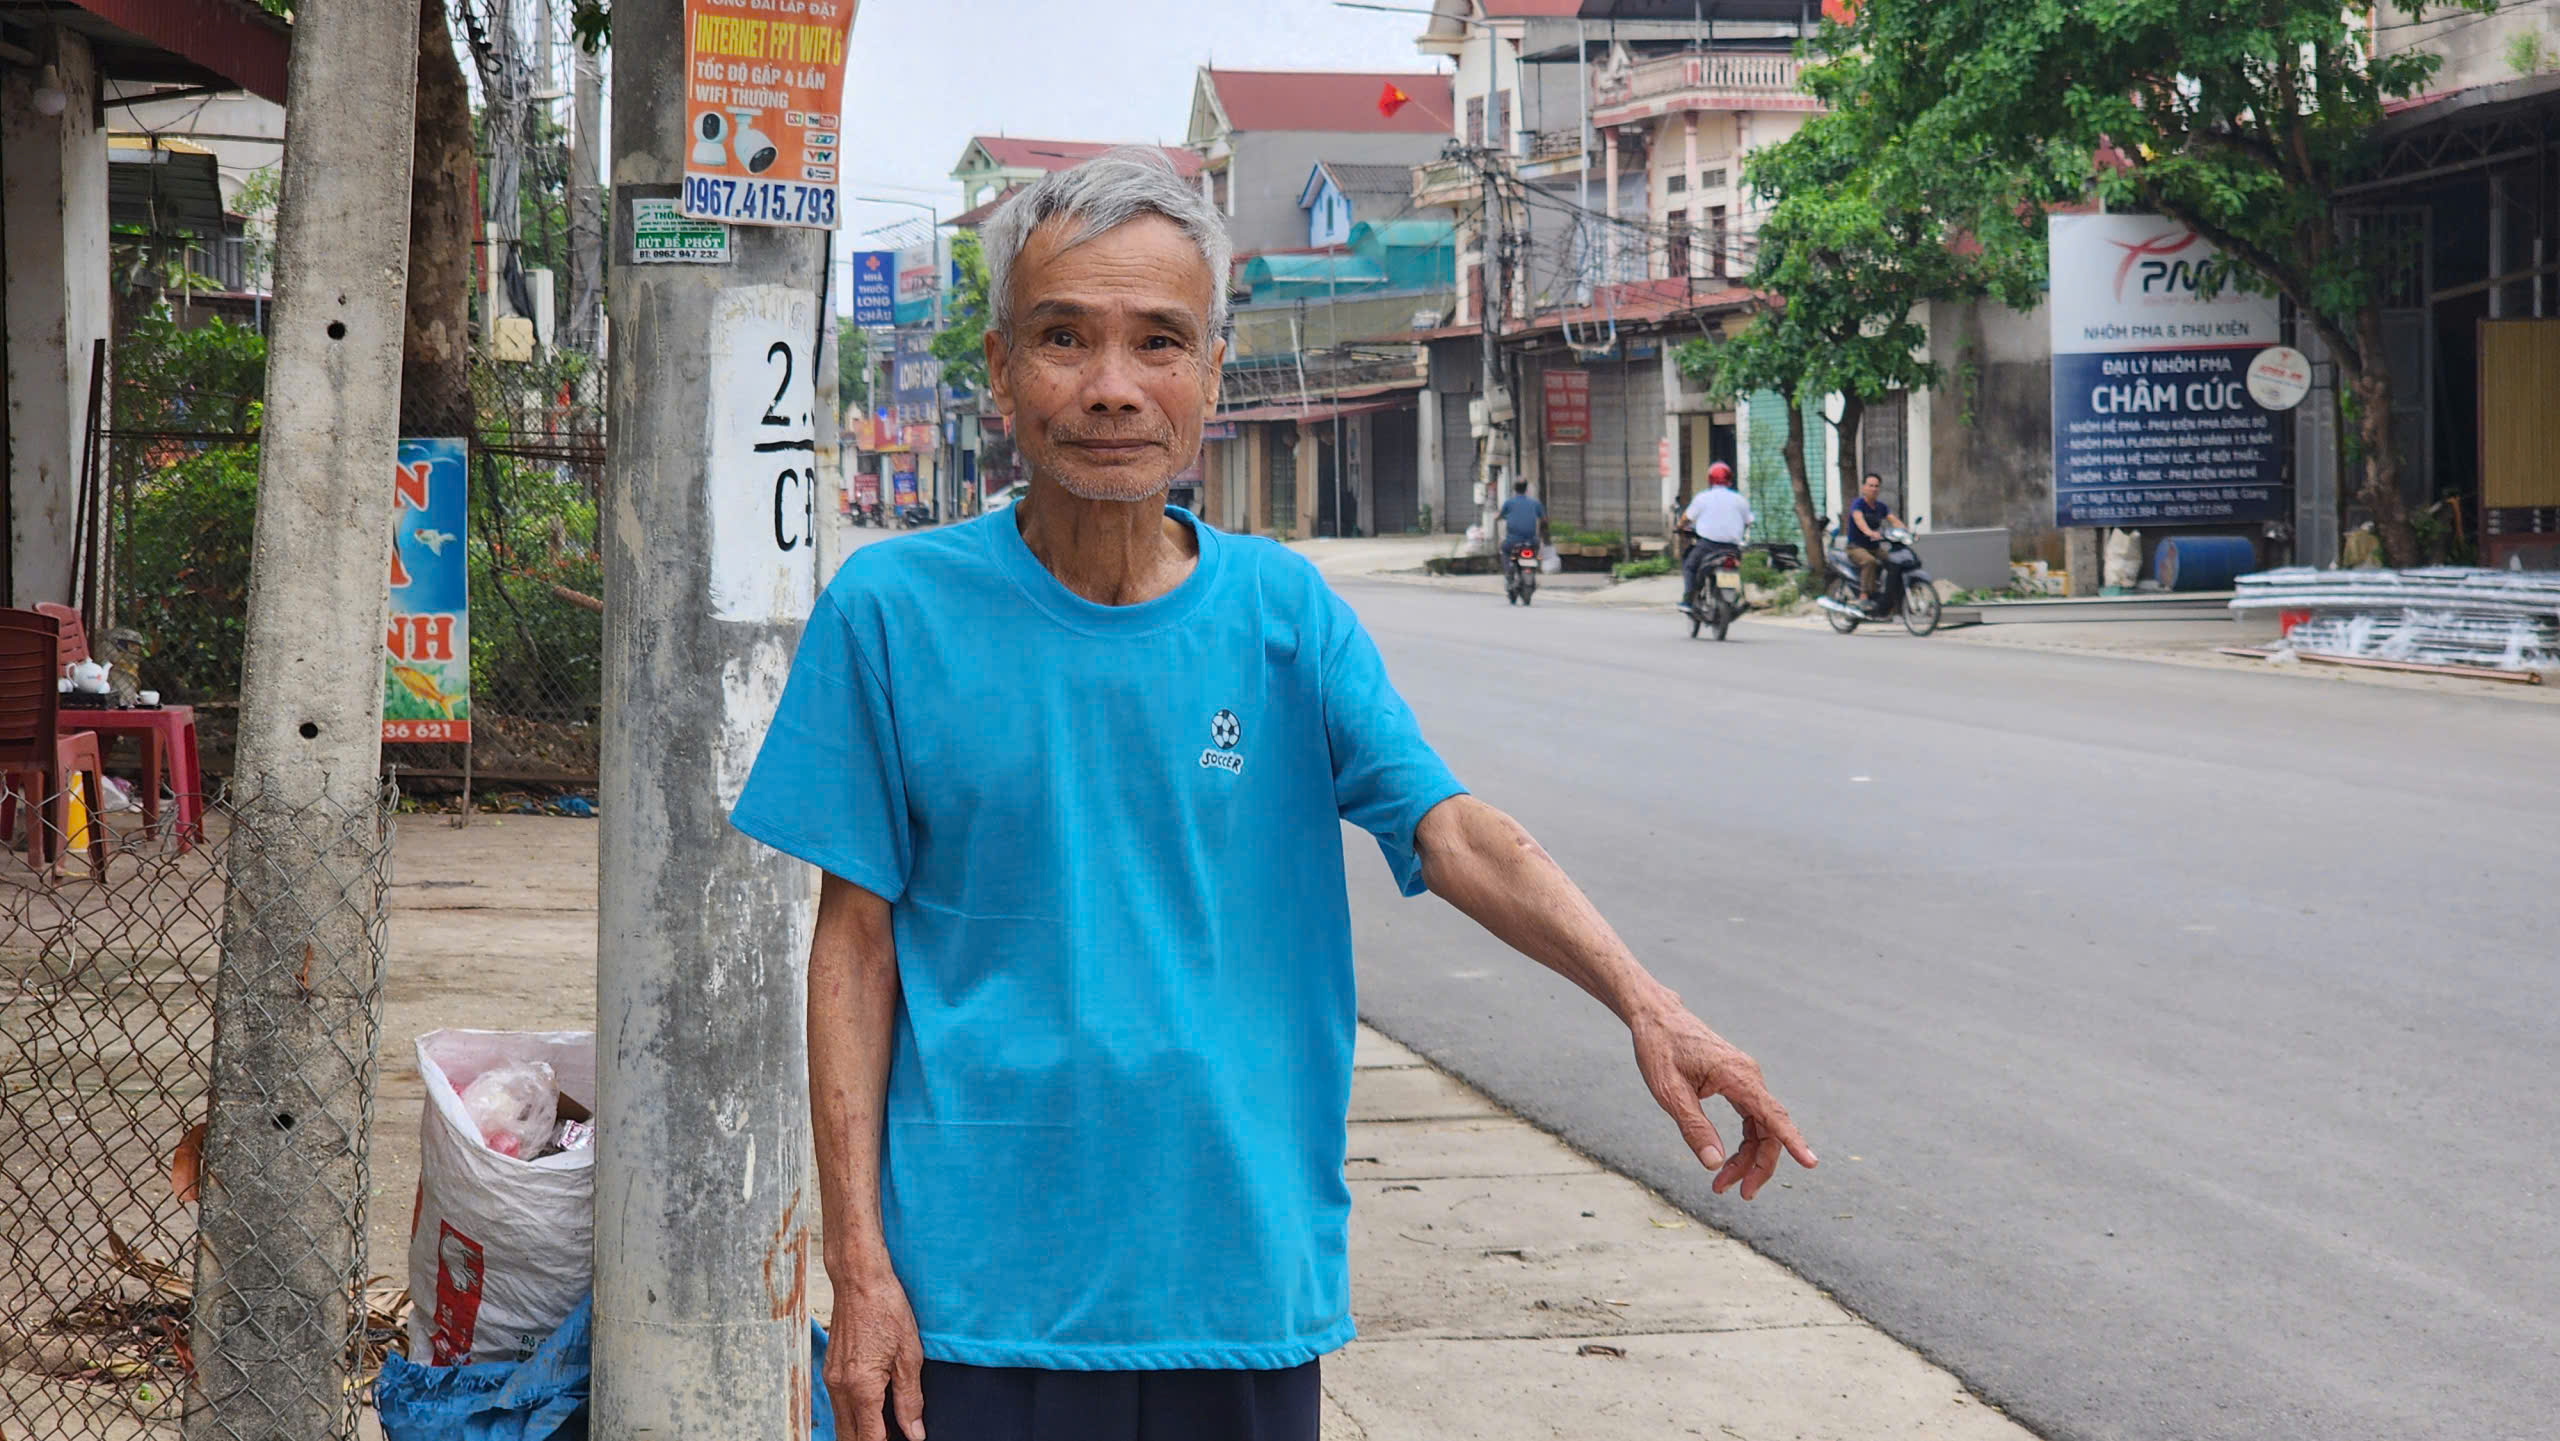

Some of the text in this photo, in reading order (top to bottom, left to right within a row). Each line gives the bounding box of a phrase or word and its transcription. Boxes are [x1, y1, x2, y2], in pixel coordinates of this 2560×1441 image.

[809, 3, 837, 20] ĐẶT
[696, 13, 842, 67] INTERNET FPT WIFI 6
[696, 57, 723, 81] TỐC
[727, 63, 748, 86] ĐỘ
[784, 72, 794, 87] 4
[797, 66, 826, 91] LẦN
[695, 84, 790, 109] WIFI THƯỜNG
[808, 150, 833, 162] VTV
[684, 175, 836, 225] 0967.415.793
[664, 232, 681, 249] BỂ
[684, 233, 721, 249] PHỐT
[653, 250, 676, 259] 0962
[679, 250, 697, 259] 947
[700, 250, 719, 259] 232
[857, 296, 891, 308] LONG
[857, 308, 892, 322] CHÂU
[2084, 323, 2127, 339] NHÔM
[2132, 325, 2162, 338] PMA
[2166, 325, 2177, 338] &
[2216, 320, 2249, 337] KIỆN
[2102, 354, 2232, 378] ĐẠI LÝ NHÔM PMA
[761, 341, 815, 426] 2.
[2092, 377, 2178, 413] CHÂM
[2186, 376, 2243, 411] CÚC
[416, 723, 451, 738] 621
[1201, 751, 1241, 773] SOCCER
